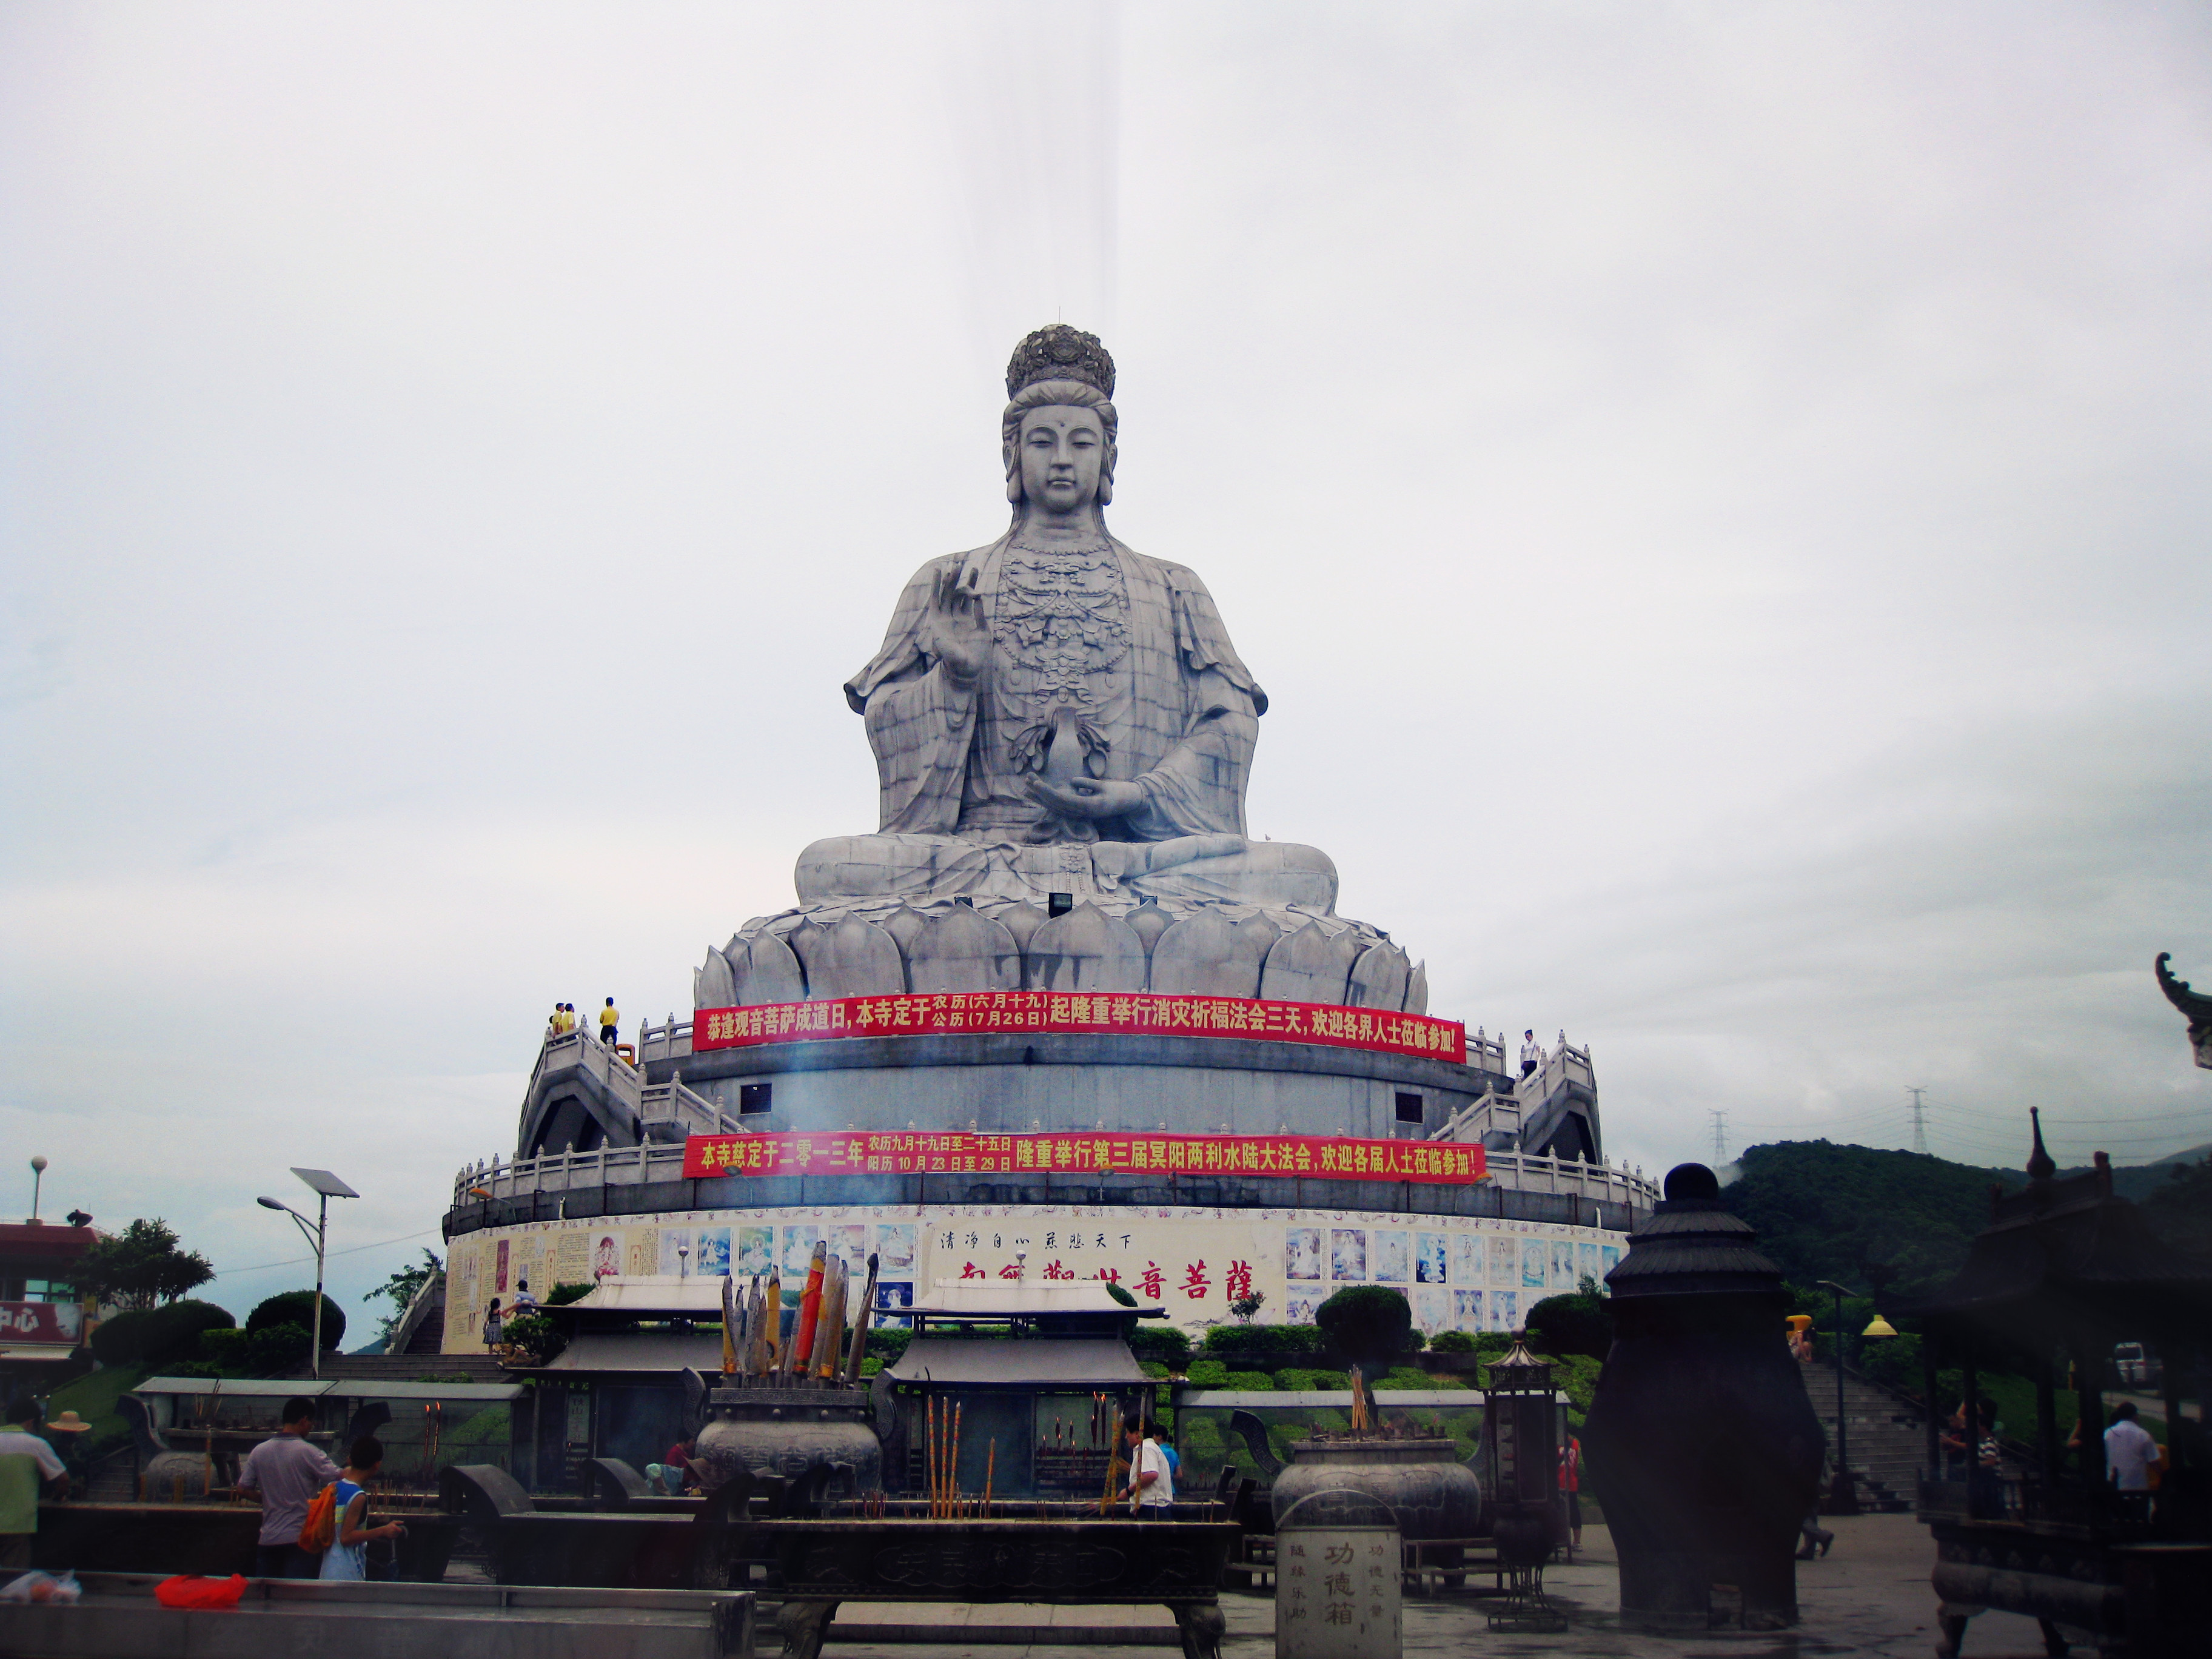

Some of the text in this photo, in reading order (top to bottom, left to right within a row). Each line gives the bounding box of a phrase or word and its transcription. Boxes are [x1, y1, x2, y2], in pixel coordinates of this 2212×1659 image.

[701, 1139, 864, 1170] 本寺慈定于二零一三年
[868, 1135, 1011, 1152] 农历九月十九日至二十五日
[1324, 1542, 1356, 1626] 功德箱
